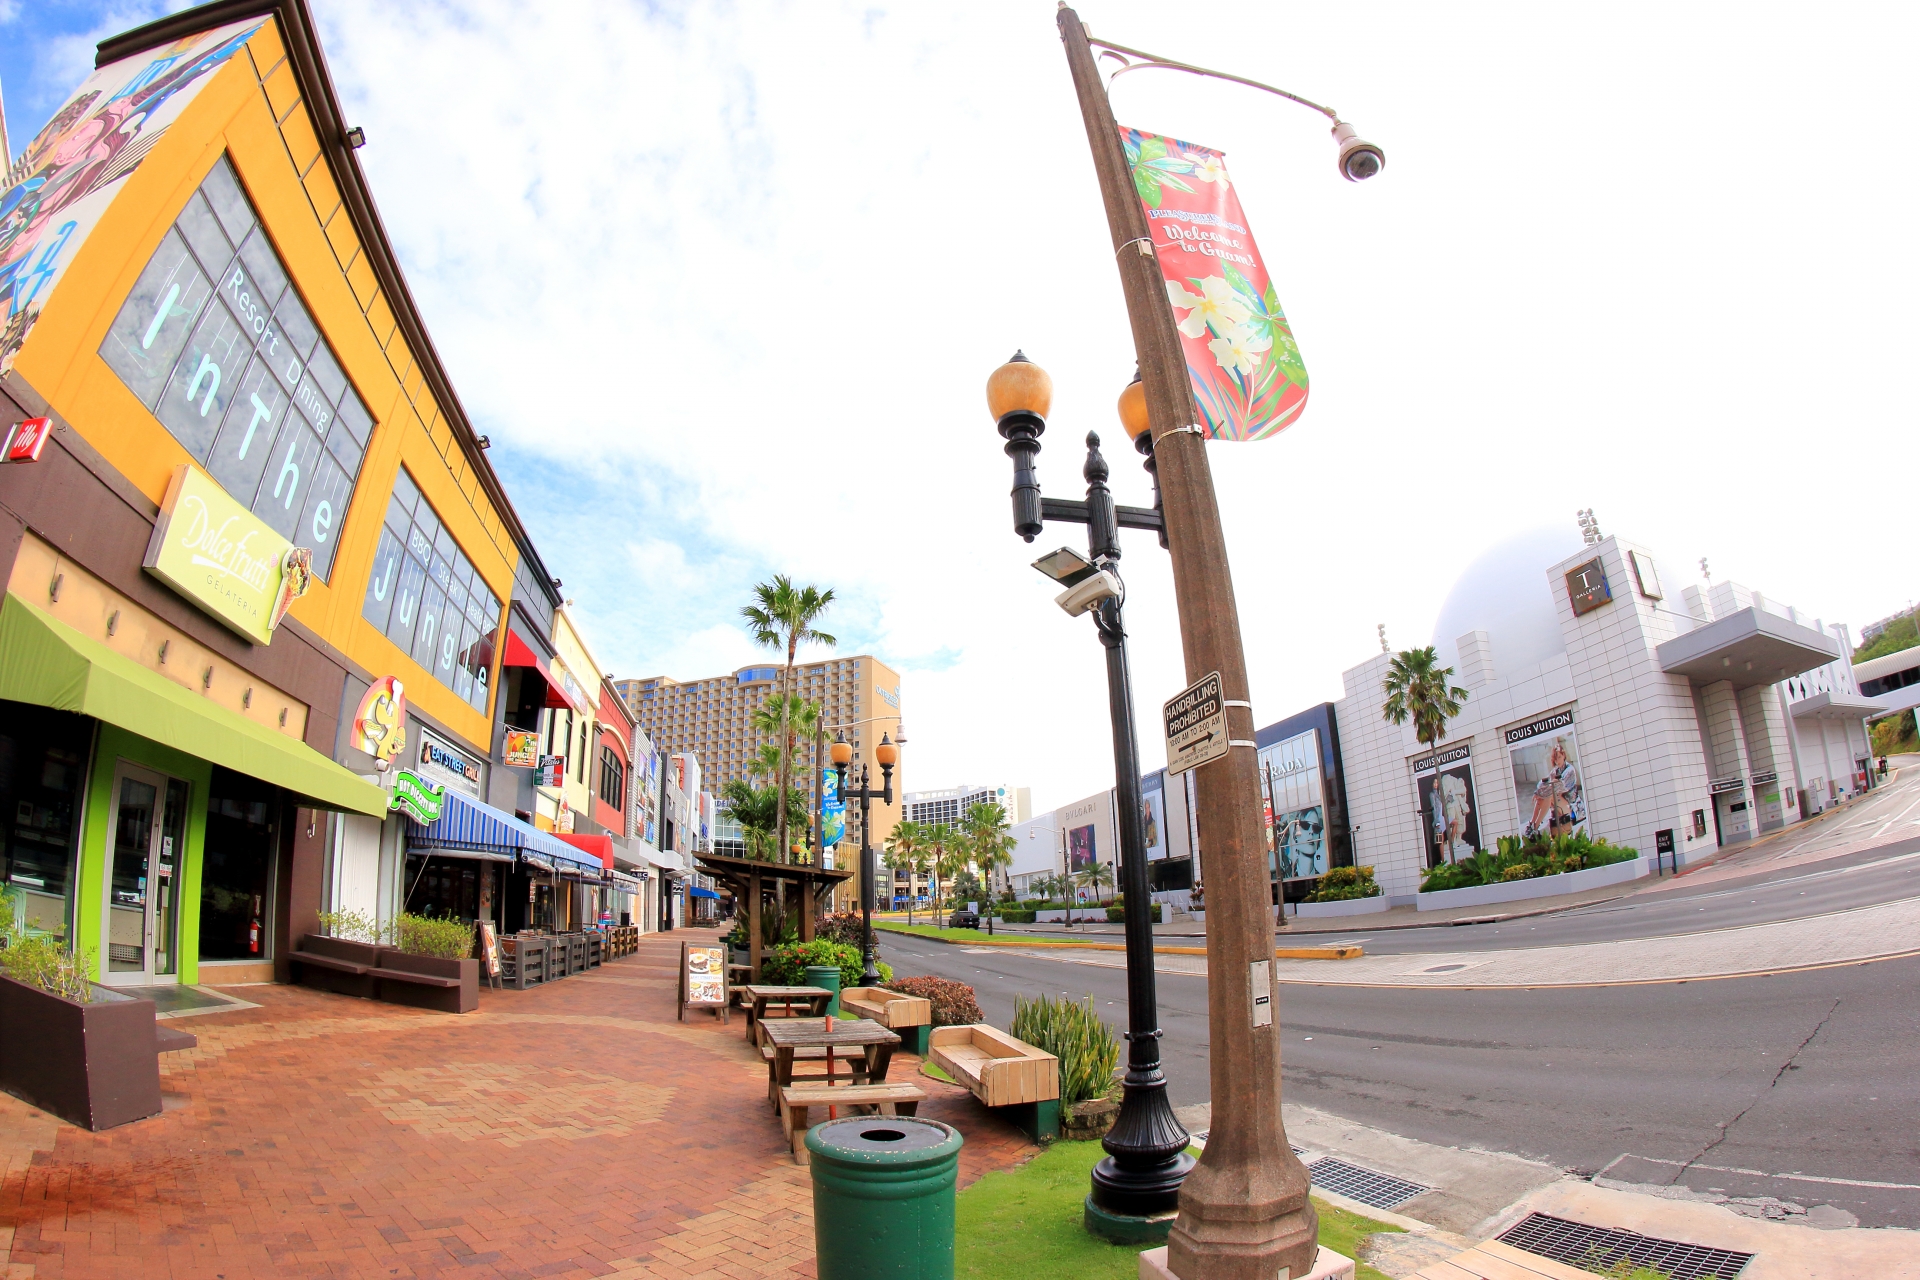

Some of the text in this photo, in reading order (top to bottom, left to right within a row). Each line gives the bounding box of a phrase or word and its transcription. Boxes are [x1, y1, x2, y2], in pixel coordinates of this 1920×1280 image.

[1163, 224, 1243, 250] Welcome
[1178, 240, 1257, 268] to Guam!
[227, 266, 329, 434] Resort Dining
[14, 424, 38, 453] illy
[181, 495, 272, 589] Dolce frutti
[238, 392, 333, 544] The
[374, 558, 488, 693] Jungle
[1576, 569, 1591, 589] T
[206, 574, 258, 619] GELATERIA
[1166, 681, 1218, 721] HANDBILLING
[1169, 700, 1216, 735] PROHIBITED
[1181, 731, 1190, 742] AM
[1190, 727, 1197, 736] TO
[1199, 721, 1210, 732] 2:00
[1211, 715, 1221, 726] AM
[1507, 713, 1570, 742] LOUIS VUITTON
[431, 746, 443, 762] EAT
[444, 753, 466, 774] STREET
[465, 764, 479, 782] GRILL
[506, 752, 536, 760] JUNGLE
[1270, 757, 1303, 777] RADA
[1415, 747, 1468, 771] LOUIS VUITTON
[1065, 803, 1097, 820] BVLGARI
